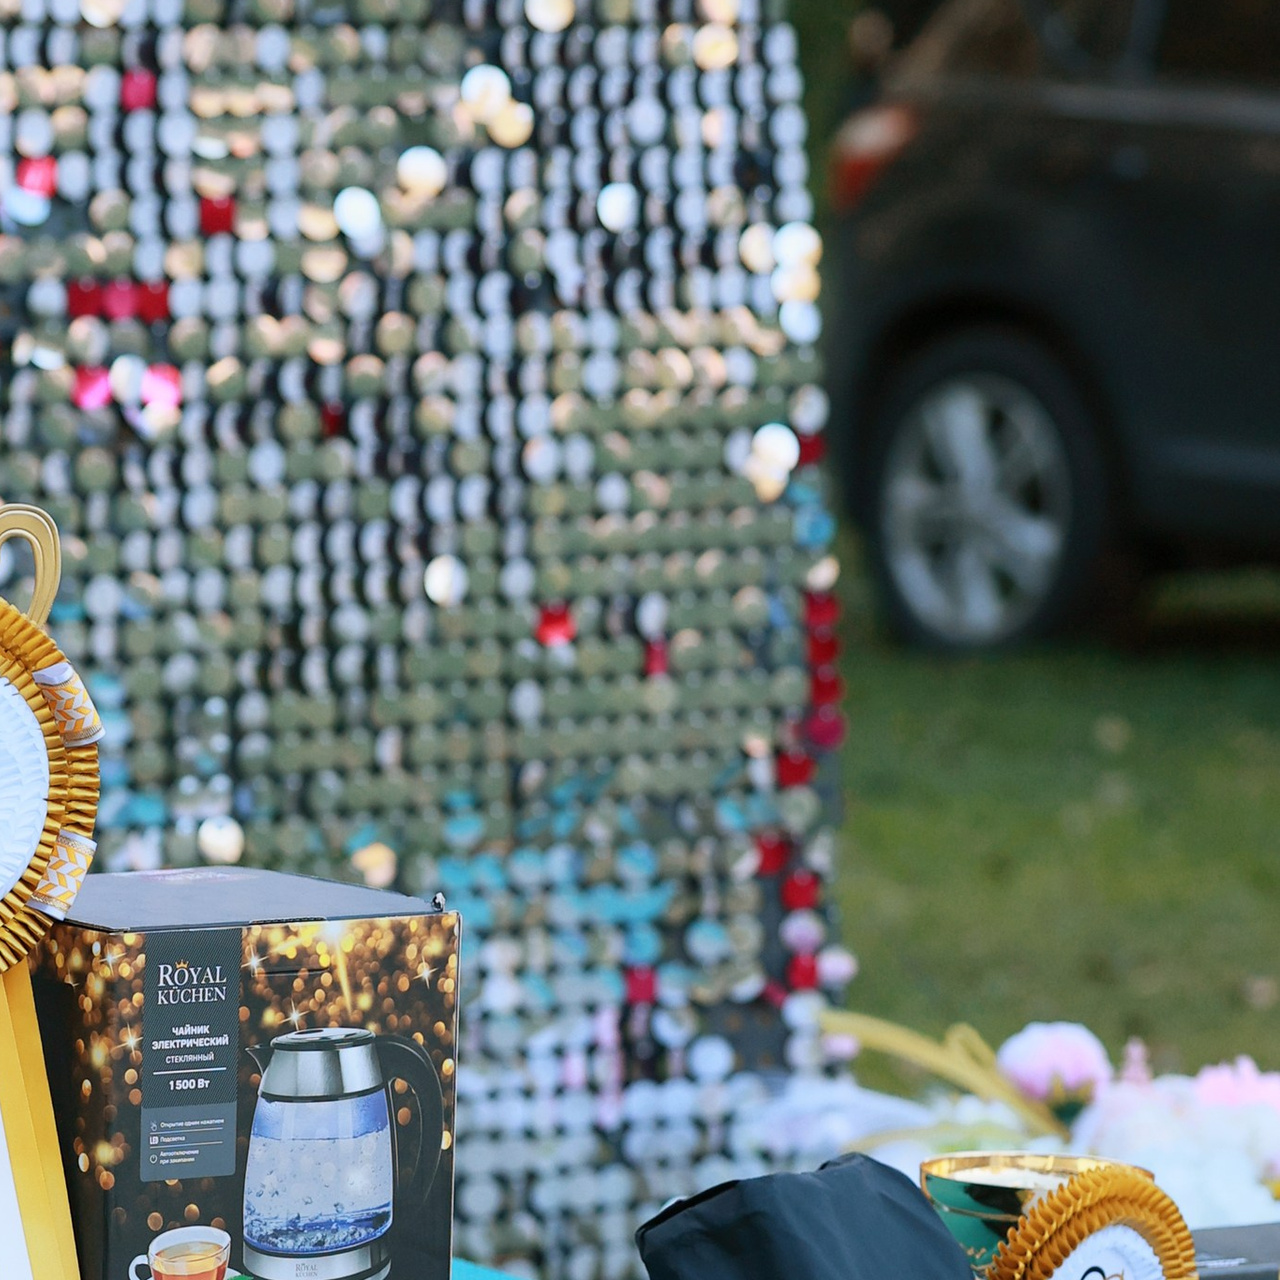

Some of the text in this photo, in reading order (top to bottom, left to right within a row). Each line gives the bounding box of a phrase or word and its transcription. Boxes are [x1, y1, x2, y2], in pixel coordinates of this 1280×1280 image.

[157, 963, 227, 987] ROYAL
[157, 986, 227, 1005] KÜCHEN
[172, 1024, 210, 1036] ЧАЙНИК
[152, 1034, 229, 1050] ЭЛЕКТРИЧЕСКИЙ
[165, 1052, 214, 1064] СТЕКЛЯННЫЙ
[197, 1078, 210, 1089] Вт
